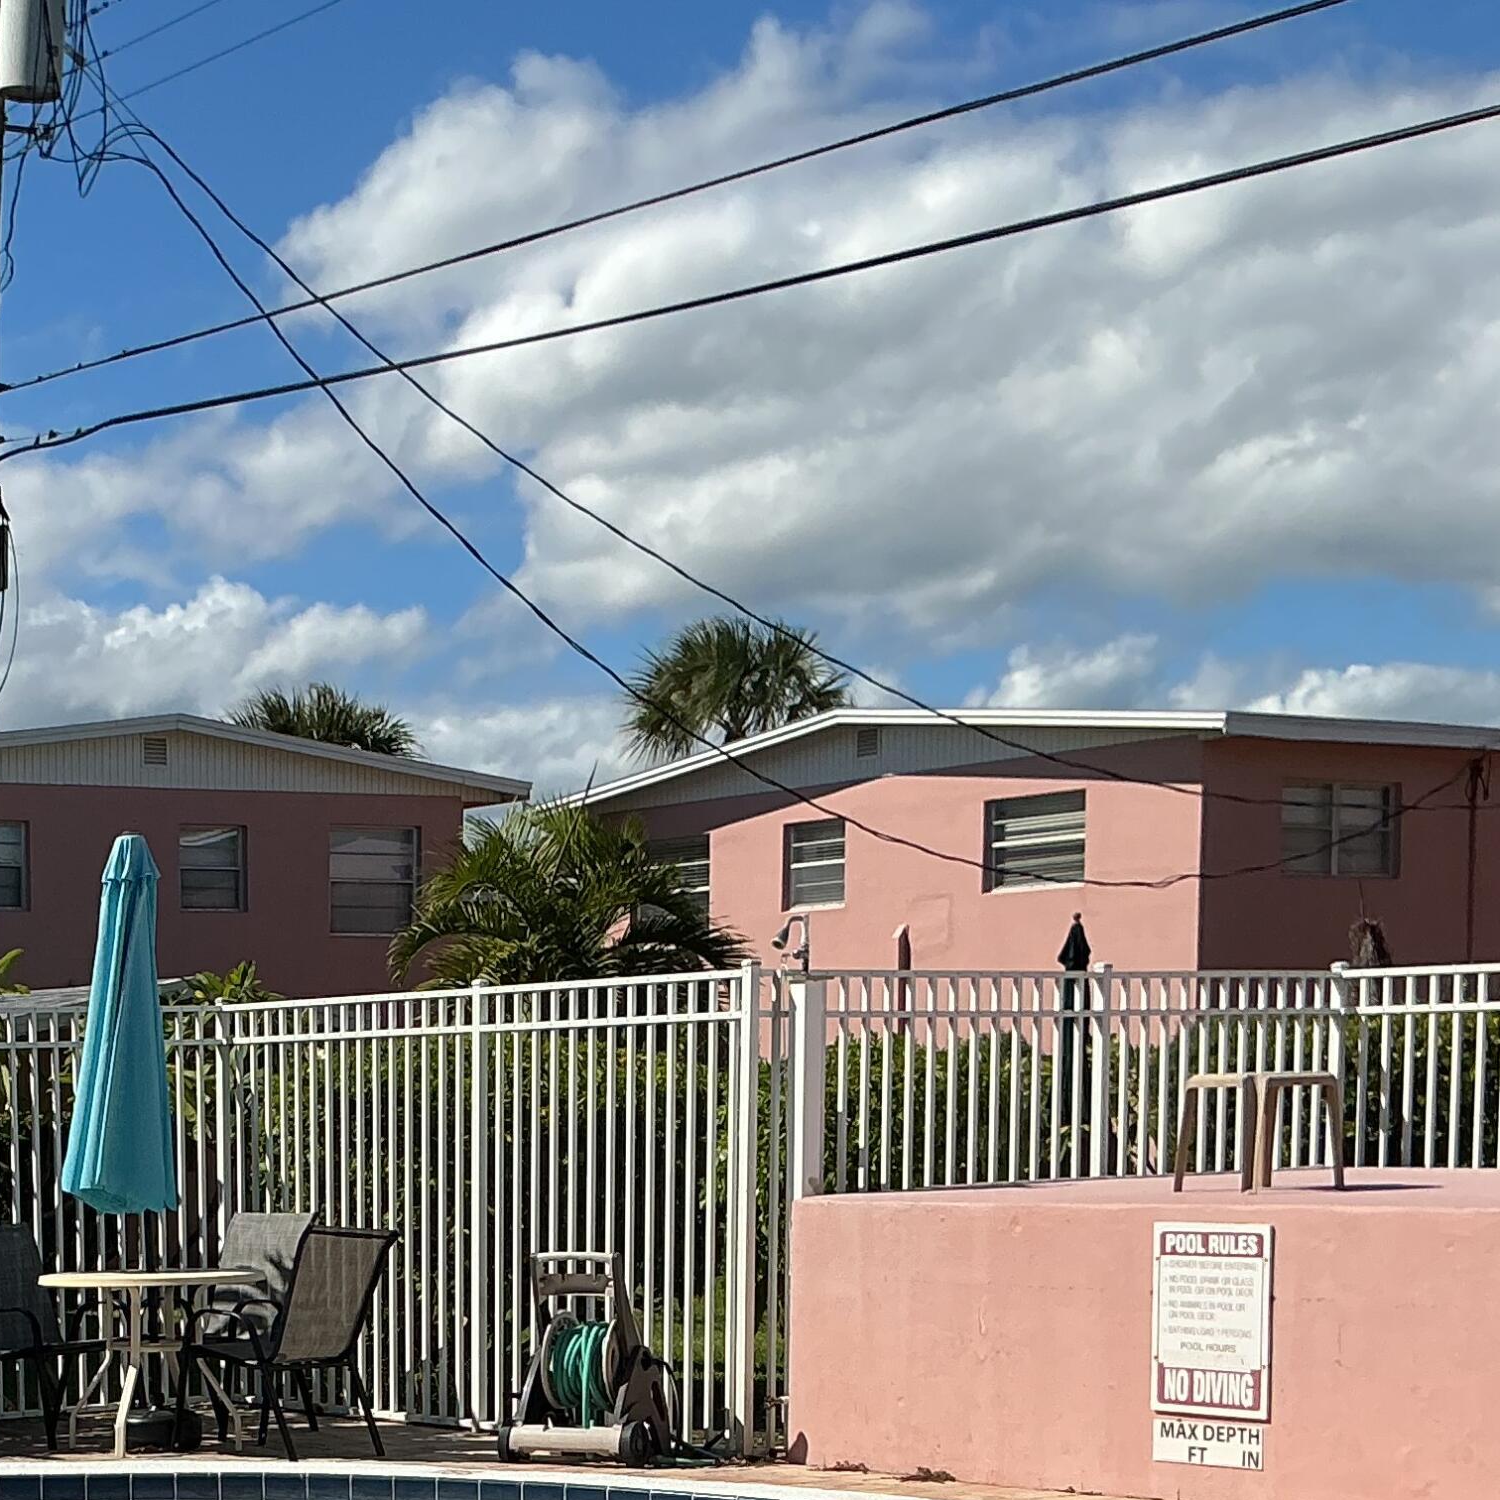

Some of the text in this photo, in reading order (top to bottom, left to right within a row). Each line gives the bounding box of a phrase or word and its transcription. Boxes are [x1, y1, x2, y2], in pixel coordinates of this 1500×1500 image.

[1165, 1233, 1259, 1255] POOL RULES
[1180, 1342, 1236, 1353] POOL HOURS
[1164, 1368, 1254, 1408] NO DIVING
[1161, 1422, 1260, 1445] MAX DEPTH
[1188, 1446, 1259, 1468] FT IN
